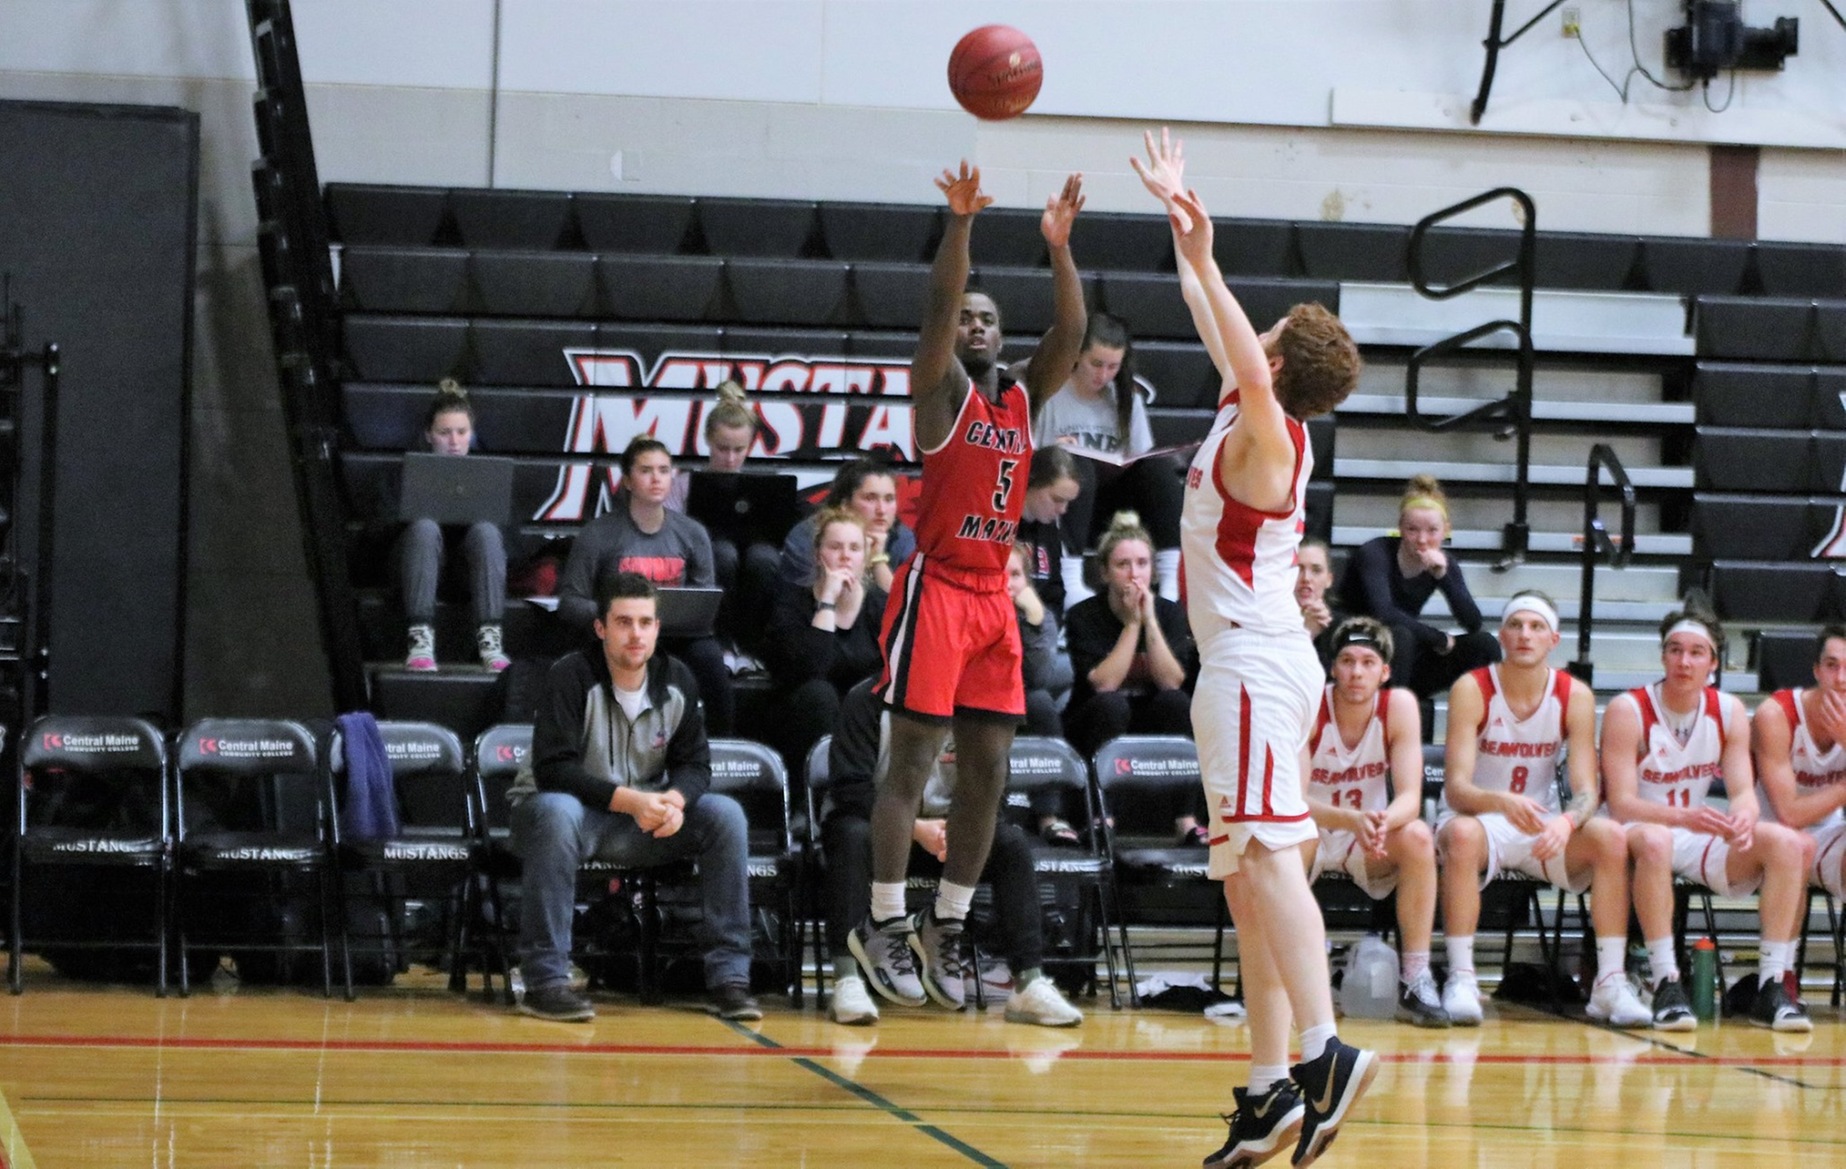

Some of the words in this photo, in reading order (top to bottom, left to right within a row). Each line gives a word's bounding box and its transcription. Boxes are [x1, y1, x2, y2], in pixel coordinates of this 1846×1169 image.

[991, 458, 1019, 513] 5
[63, 735, 103, 747] Central
[105, 735, 139, 746] Maine
[218, 740, 258, 751] Central
[260, 740, 294, 751] Maine
[407, 743, 440, 753] Maine
[727, 762, 760, 772] Maine
[1029, 758, 1061, 768] Maine
[1130, 760, 1166, 770] Central
[1167, 760, 1199, 770] Maine
[1509, 765, 1529, 794] 8
[1331, 788, 1363, 811] 13
[1666, 787, 1690, 808] 11
[383, 847, 470, 861] MUSTANGS
